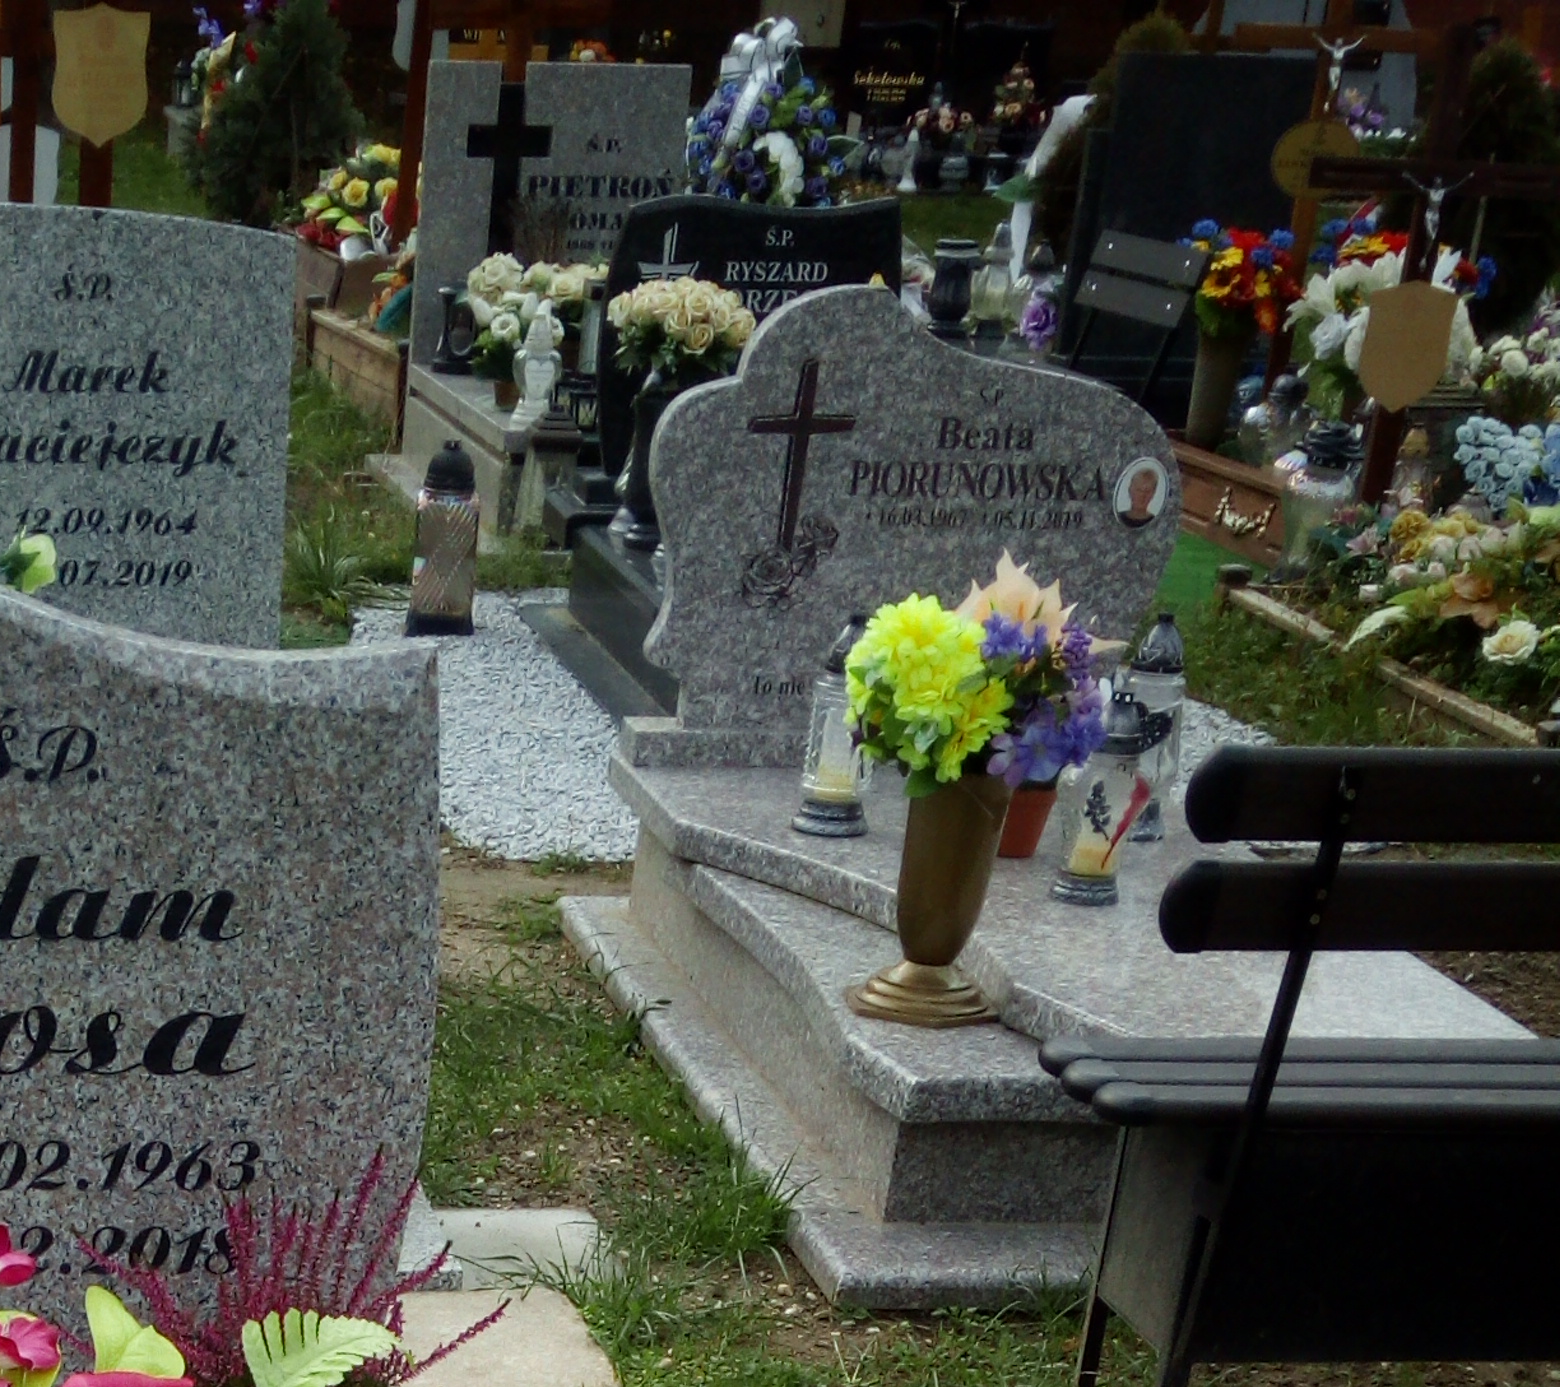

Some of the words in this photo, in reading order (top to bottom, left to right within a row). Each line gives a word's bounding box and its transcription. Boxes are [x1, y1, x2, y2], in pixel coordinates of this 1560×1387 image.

[724, 261, 829, 283] RYSZARD
[5, 350, 170, 396] Marek
[938, 416, 1035, 452] Beata
[848, 458, 1107, 502] PIORUNOWSKA
